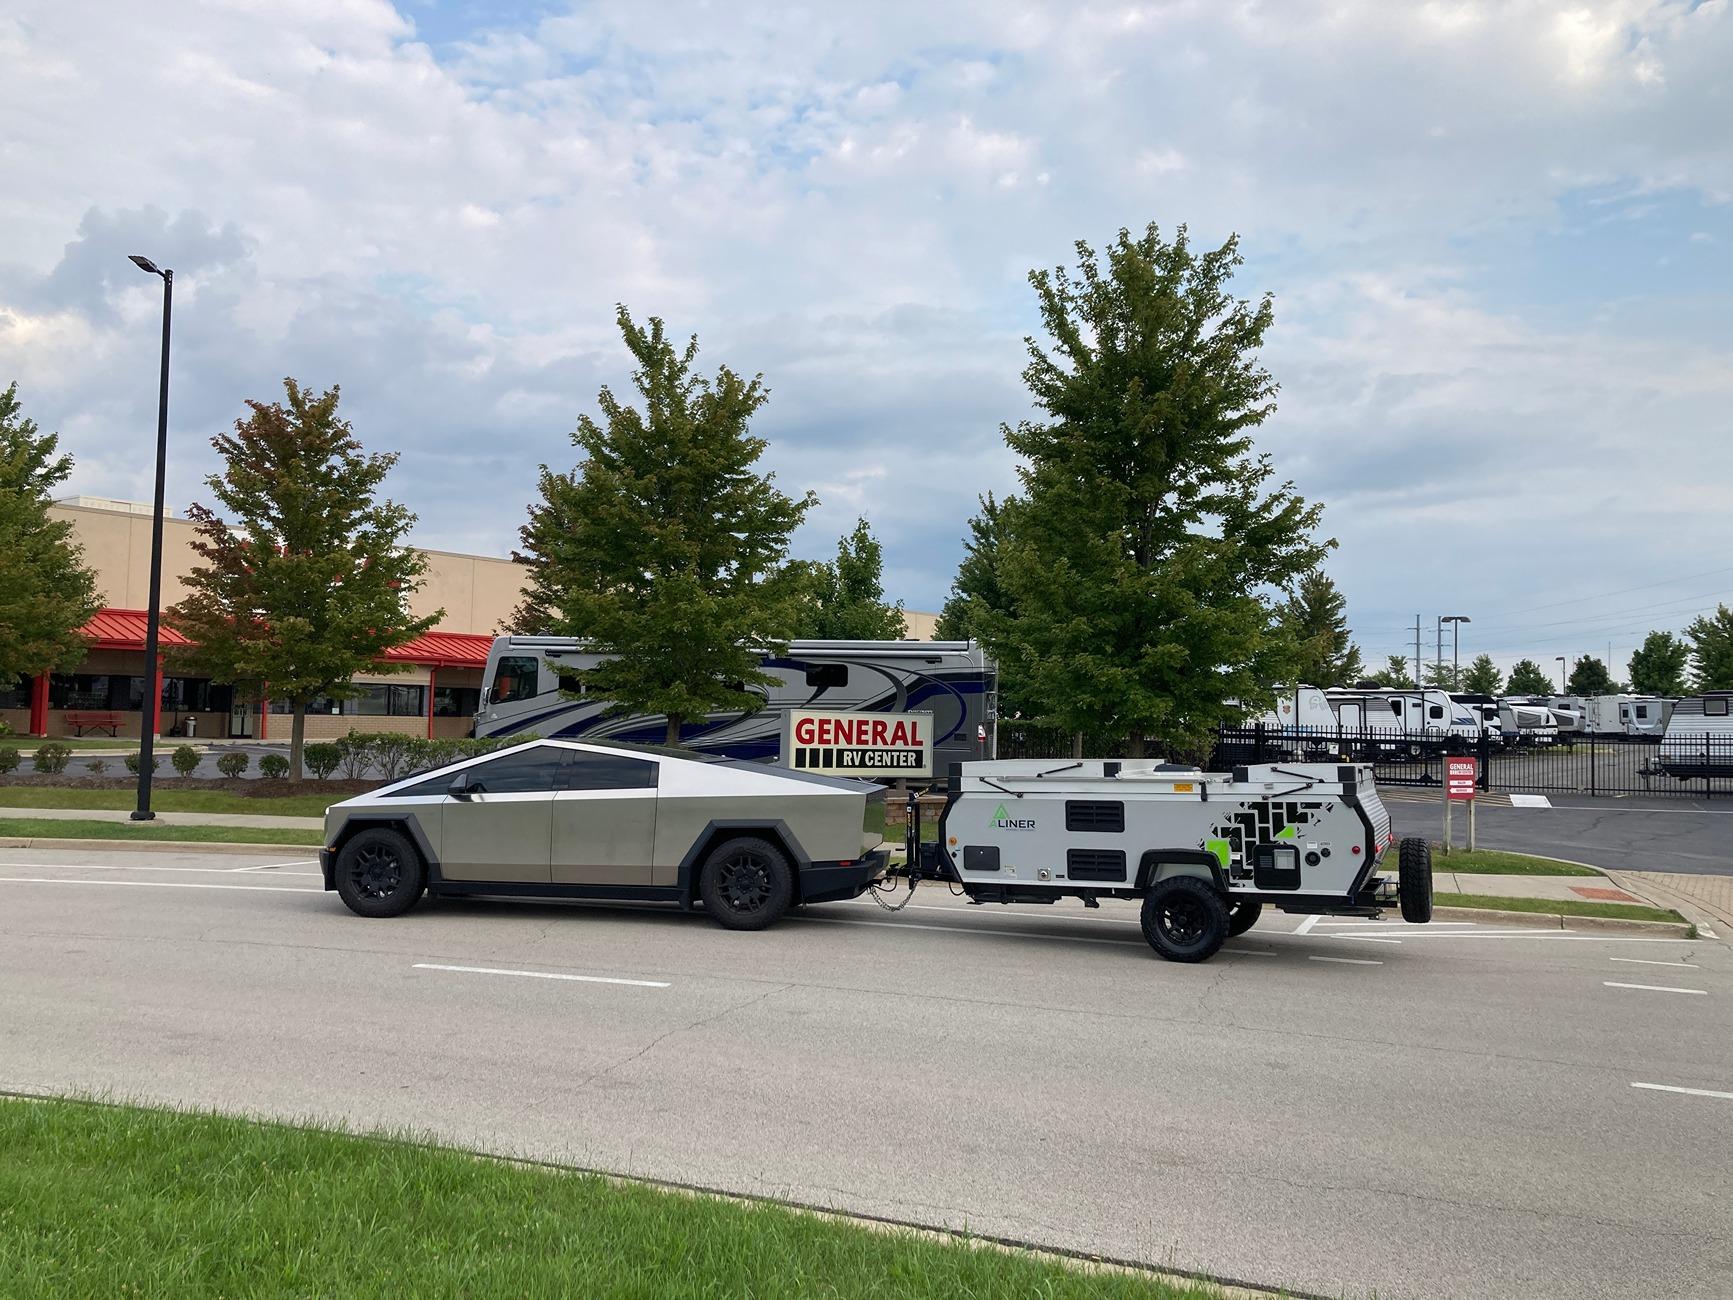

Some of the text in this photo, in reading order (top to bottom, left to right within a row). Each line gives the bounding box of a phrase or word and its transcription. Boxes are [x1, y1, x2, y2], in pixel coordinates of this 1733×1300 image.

[795, 718, 923, 746] GENERAL
[843, 751, 916, 767] RV CENTER
